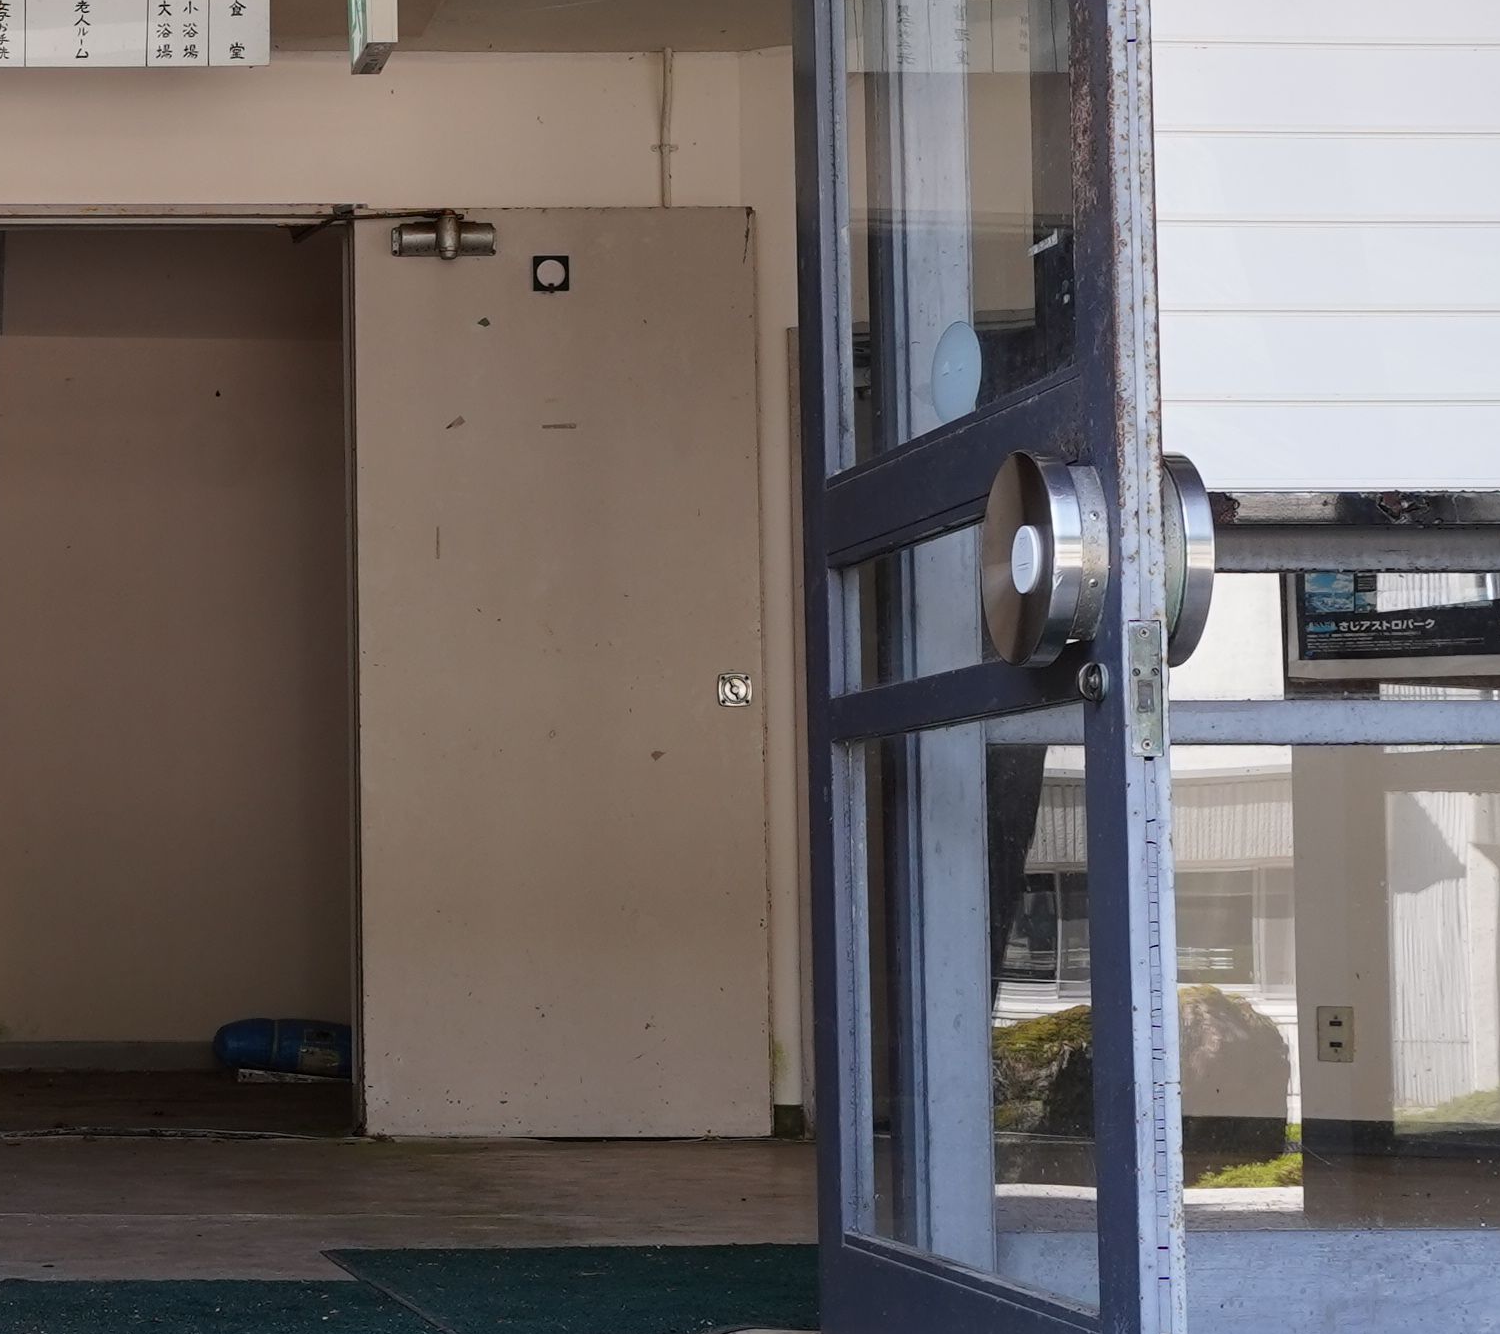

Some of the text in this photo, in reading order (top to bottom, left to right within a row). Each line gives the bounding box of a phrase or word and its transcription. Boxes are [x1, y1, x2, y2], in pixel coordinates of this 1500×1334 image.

[74, 0, 91, 60] 老人ルーム
[156, 0, 173, 59] 大浴場
[183, 0, 200, 59] 小浴場
[1338, 618, 1436, 632] さじアストロパーク
